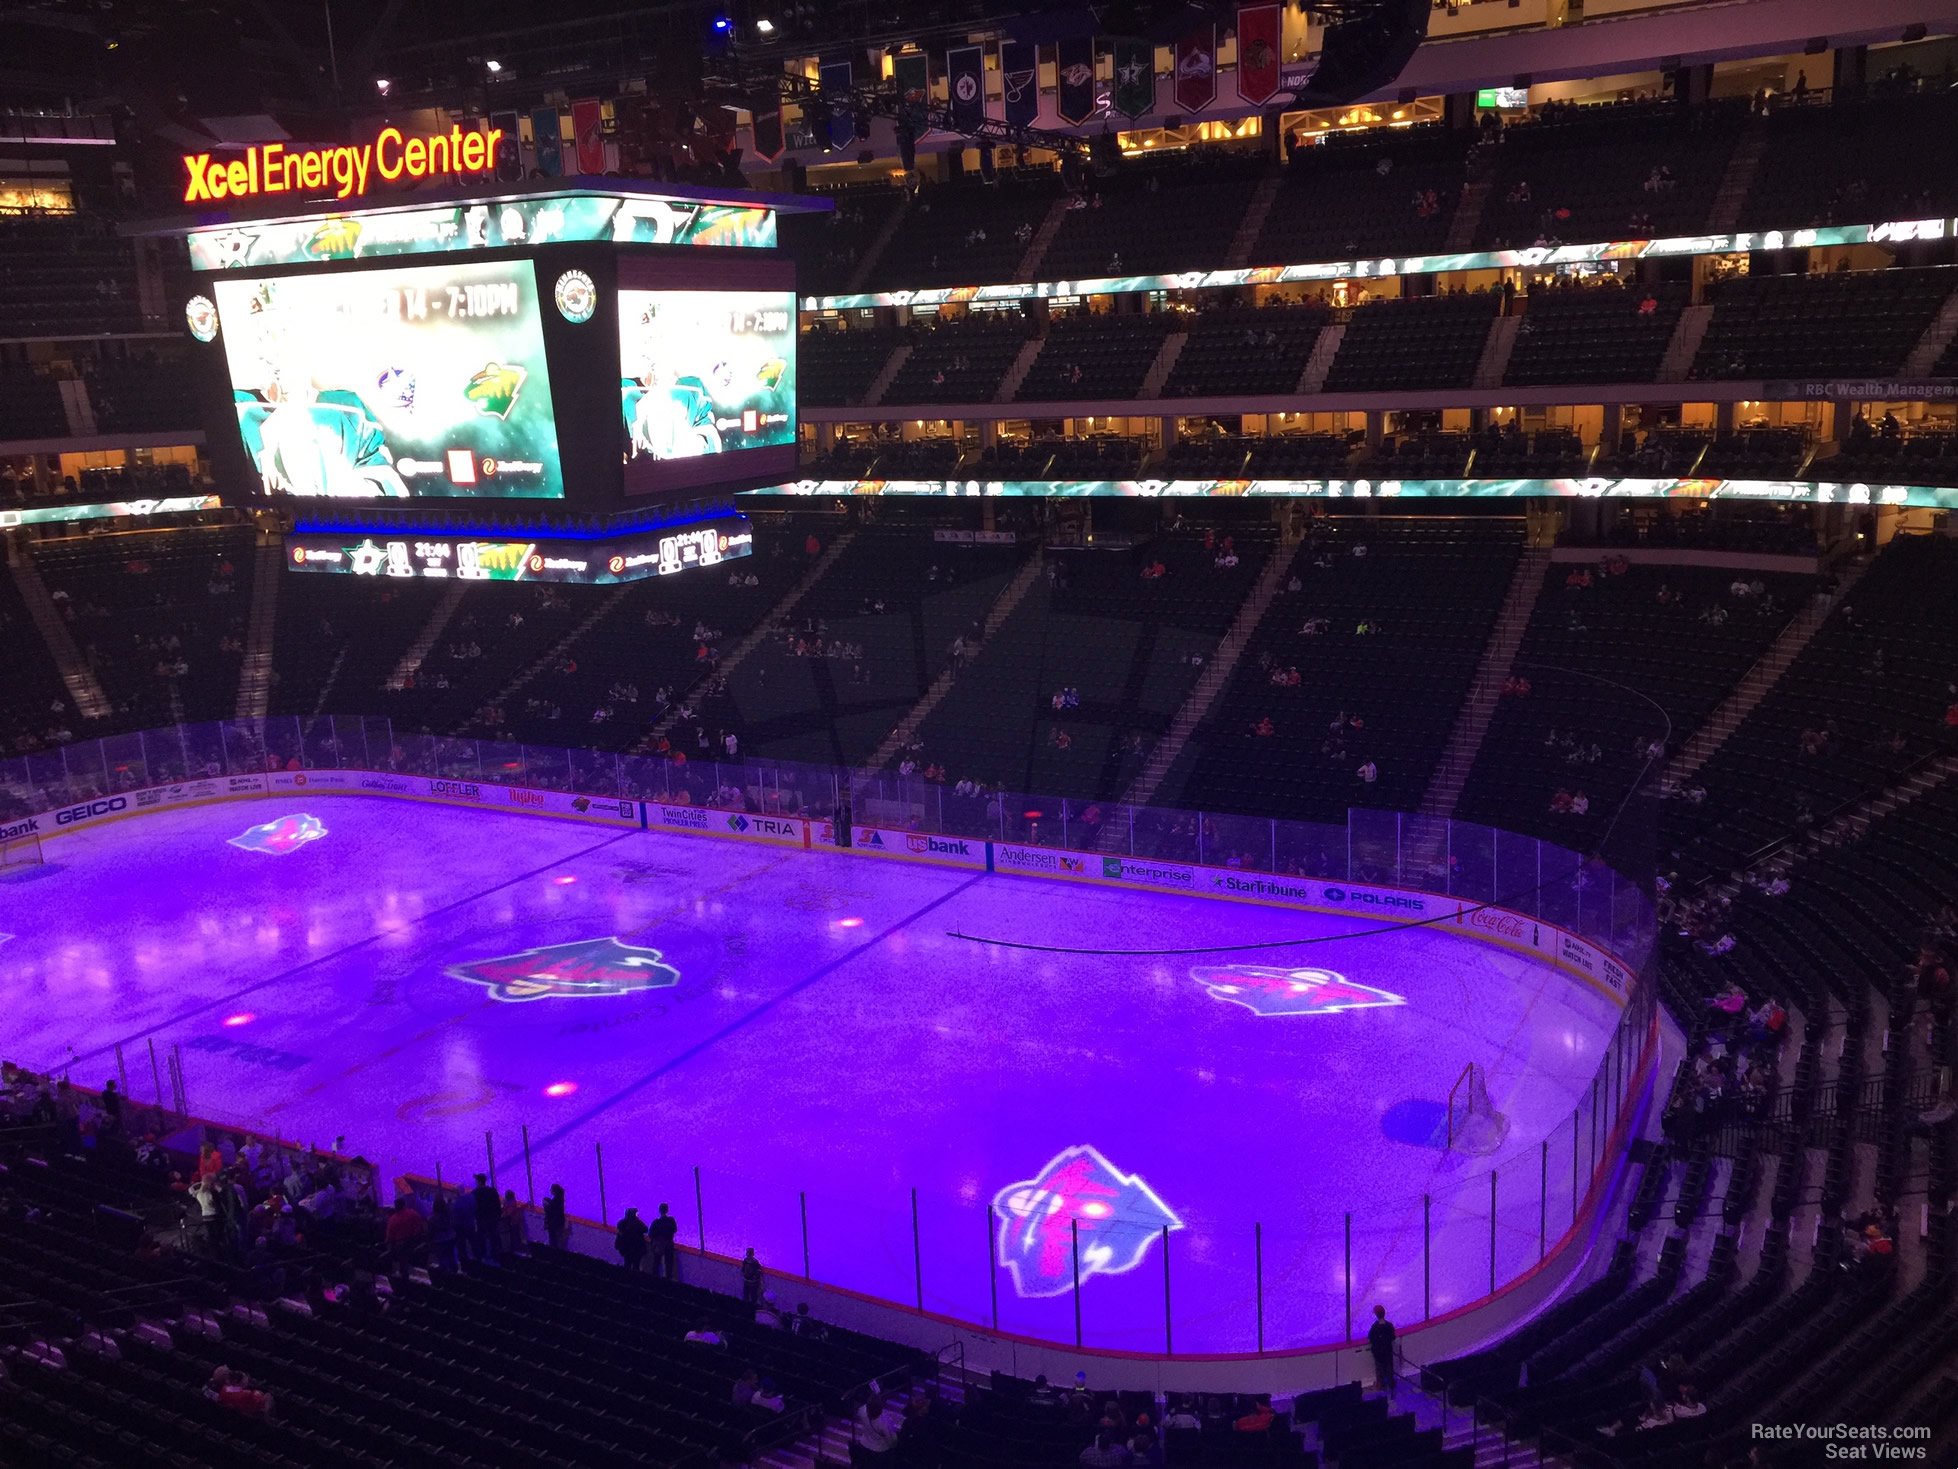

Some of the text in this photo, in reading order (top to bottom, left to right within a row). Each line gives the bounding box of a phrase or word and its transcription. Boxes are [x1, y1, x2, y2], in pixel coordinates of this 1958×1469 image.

[184, 125, 502, 201] Xcel Energy Center
[446, 283, 518, 319] 7:10PM
[1805, 383, 1834, 396] RBC
[1837, 382, 1884, 396] Wealth
[430, 780, 480, 797] LOFFLER
[56, 797, 127, 825] GEICO
[0, 818, 40, 839] bank
[752, 819, 796, 837] TRIA
[1000, 846, 1056, 866] Andersen
[1350, 891, 1425, 911] POLARIS
[1603, 959, 1624, 980] FRESH
[1605, 973, 1623, 990] FAST
